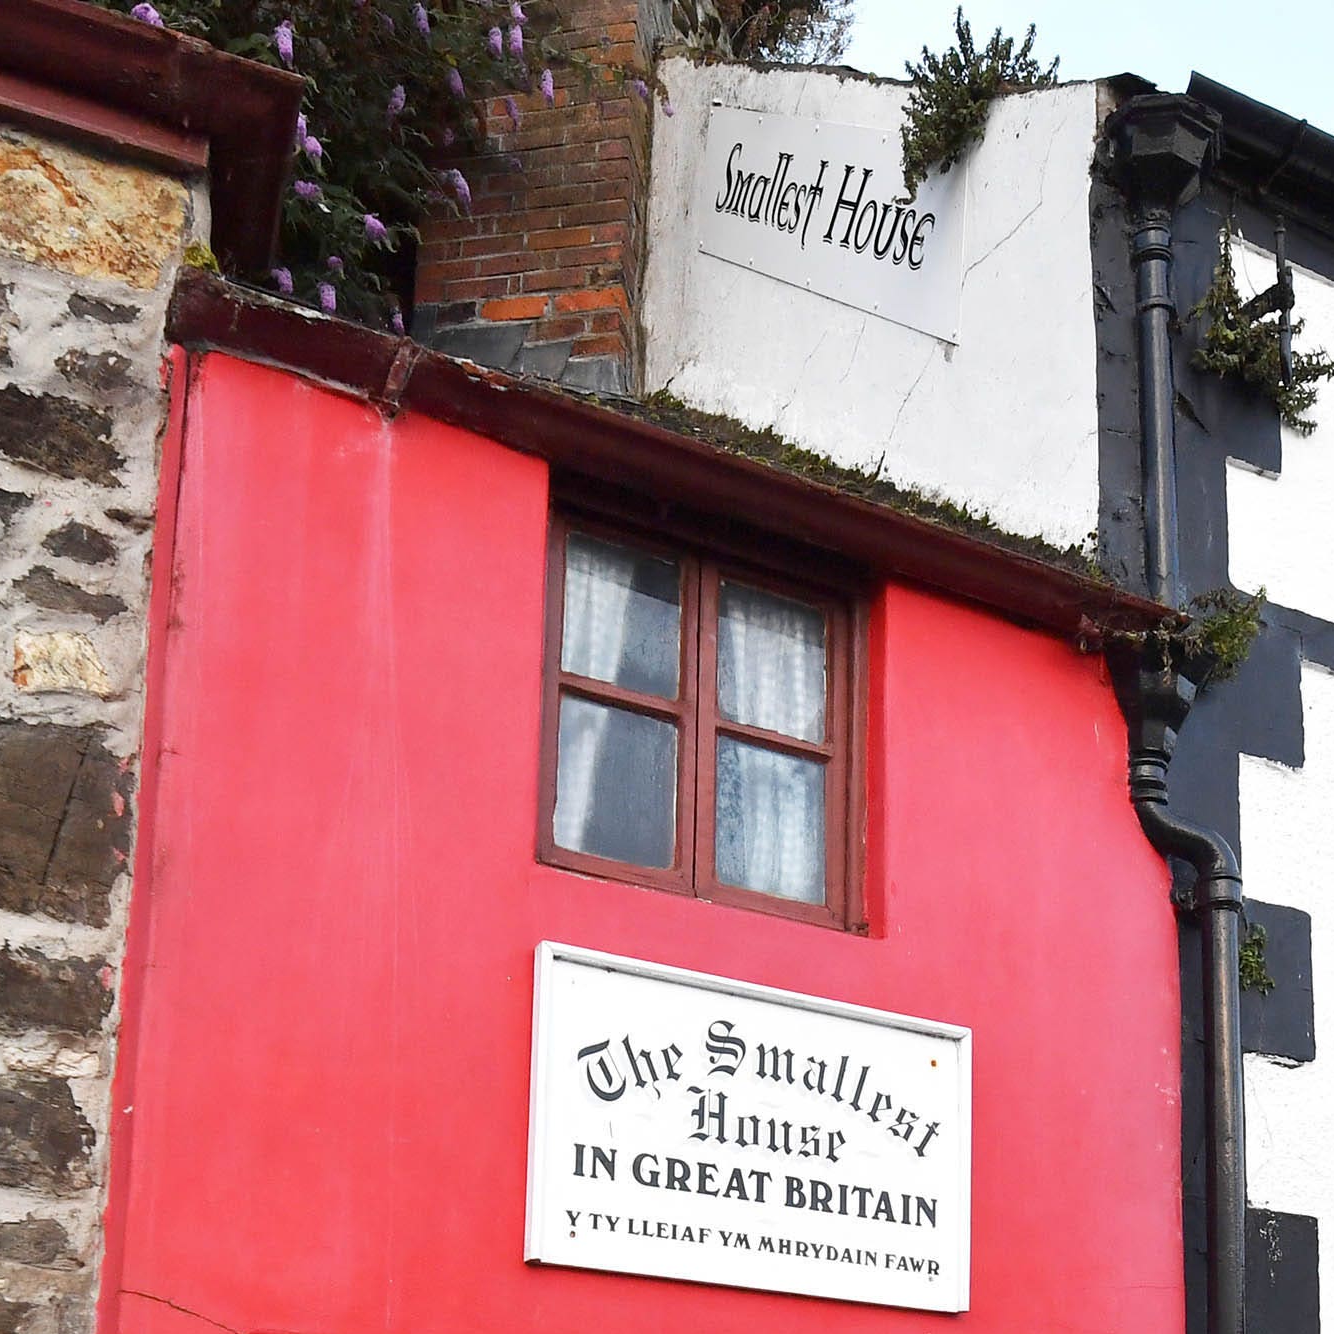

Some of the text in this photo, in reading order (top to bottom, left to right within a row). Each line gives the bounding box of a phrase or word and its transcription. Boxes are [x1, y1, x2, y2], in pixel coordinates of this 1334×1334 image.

[715, 142, 936, 270] Smallest House
[577, 1020, 940, 1158] The Smallest
[687, 1086, 848, 1163] House
[572, 1143, 939, 1229] IN GREAT BRITAIN
[566, 1210, 941, 1277] Y TY LLEIAF YM MHRYDAIN FAWR
